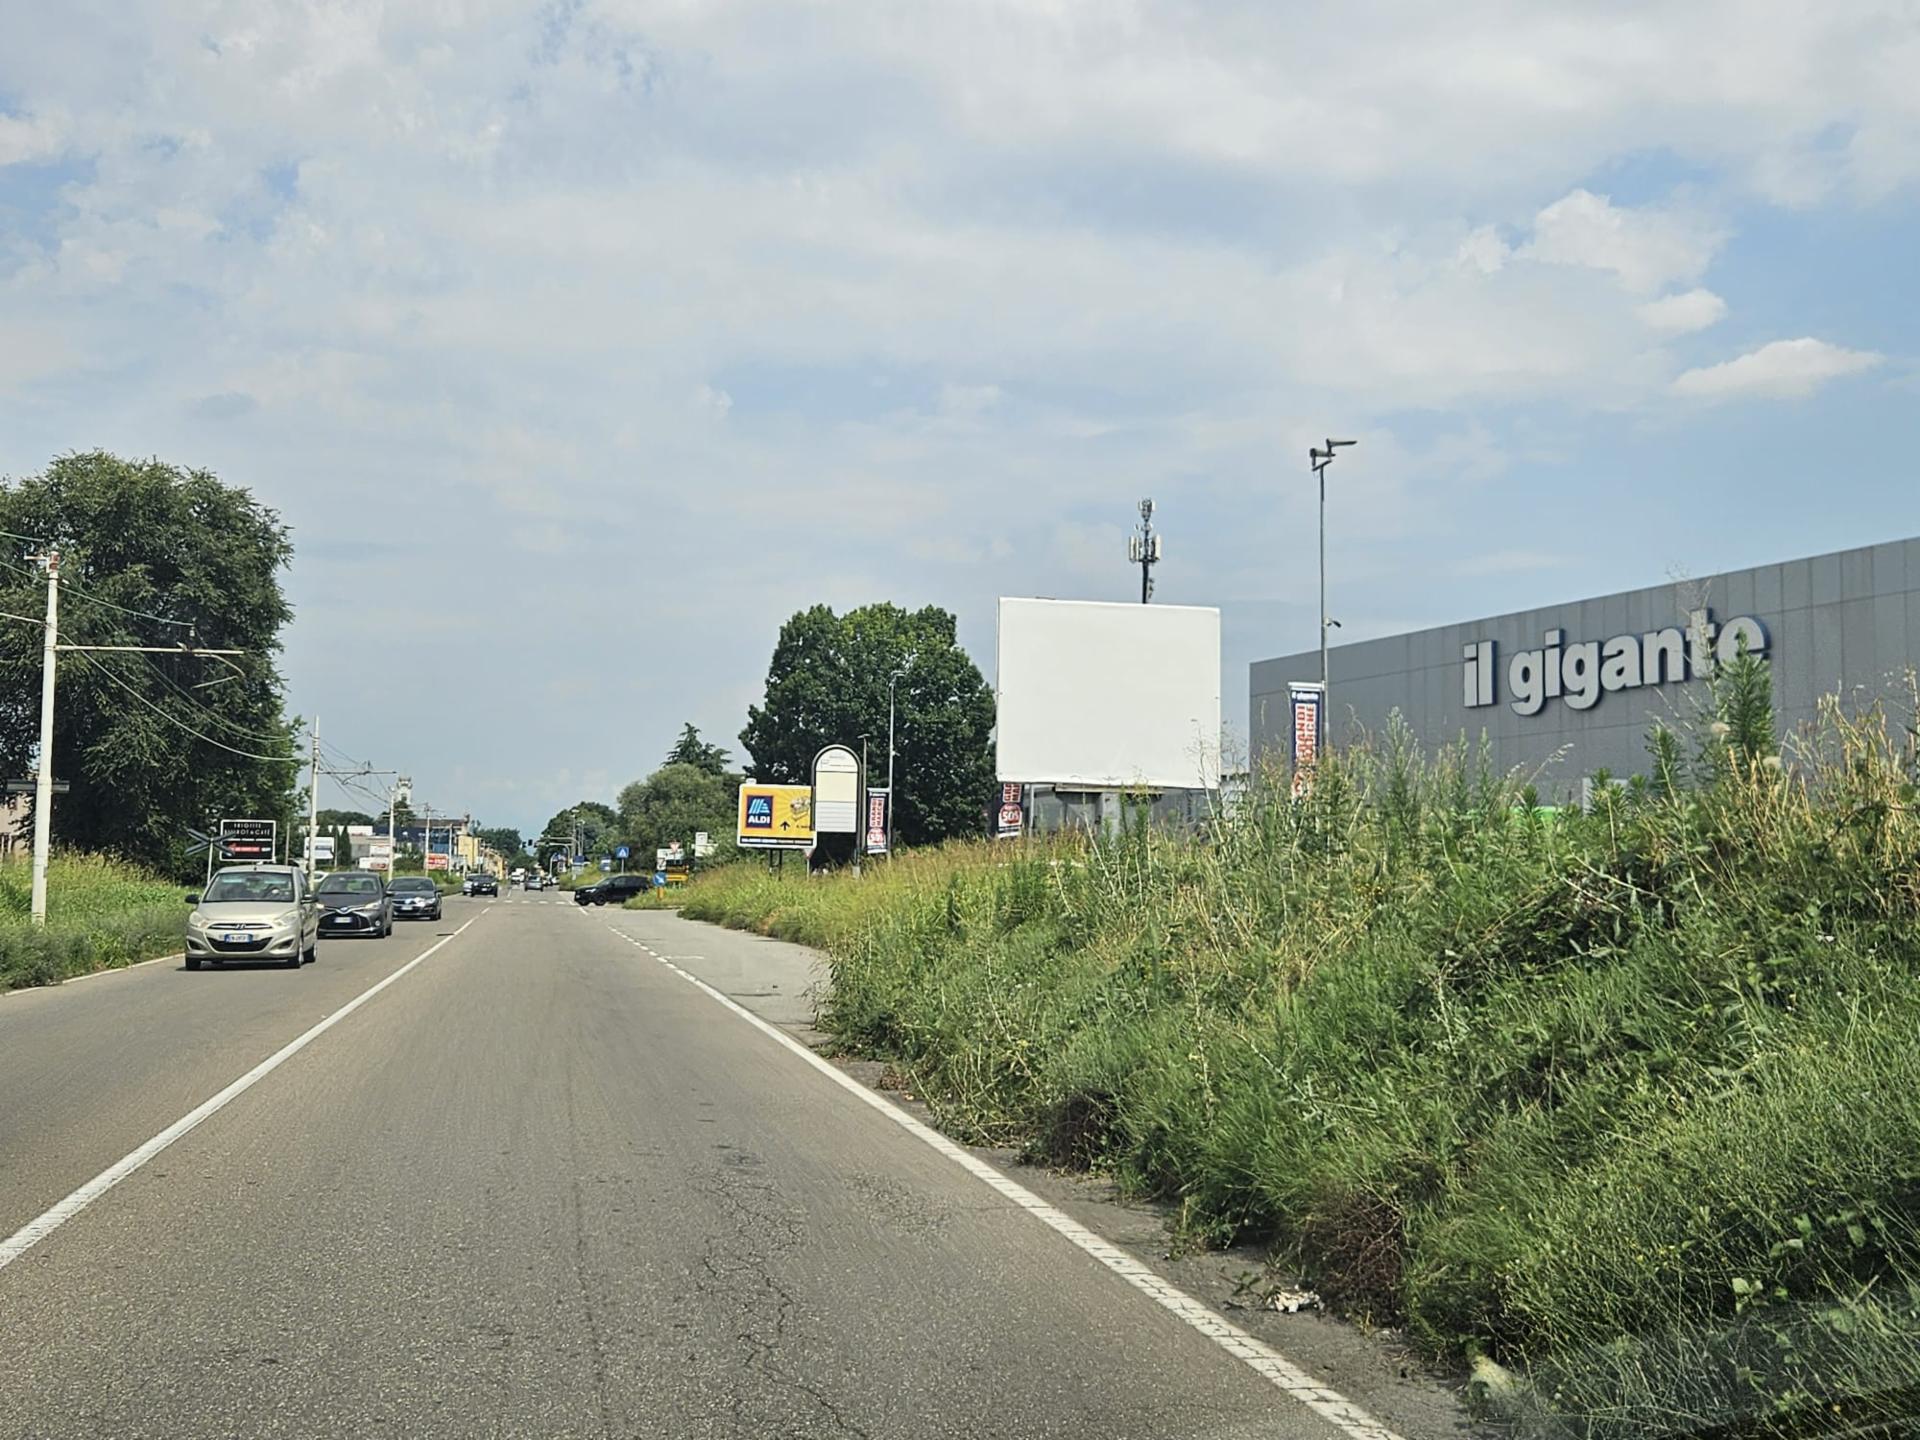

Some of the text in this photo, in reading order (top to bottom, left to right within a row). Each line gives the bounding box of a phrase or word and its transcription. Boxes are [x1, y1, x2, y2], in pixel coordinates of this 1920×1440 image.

[1463, 607, 1770, 716] il gigante
[747, 815, 771, 824] ALDI
